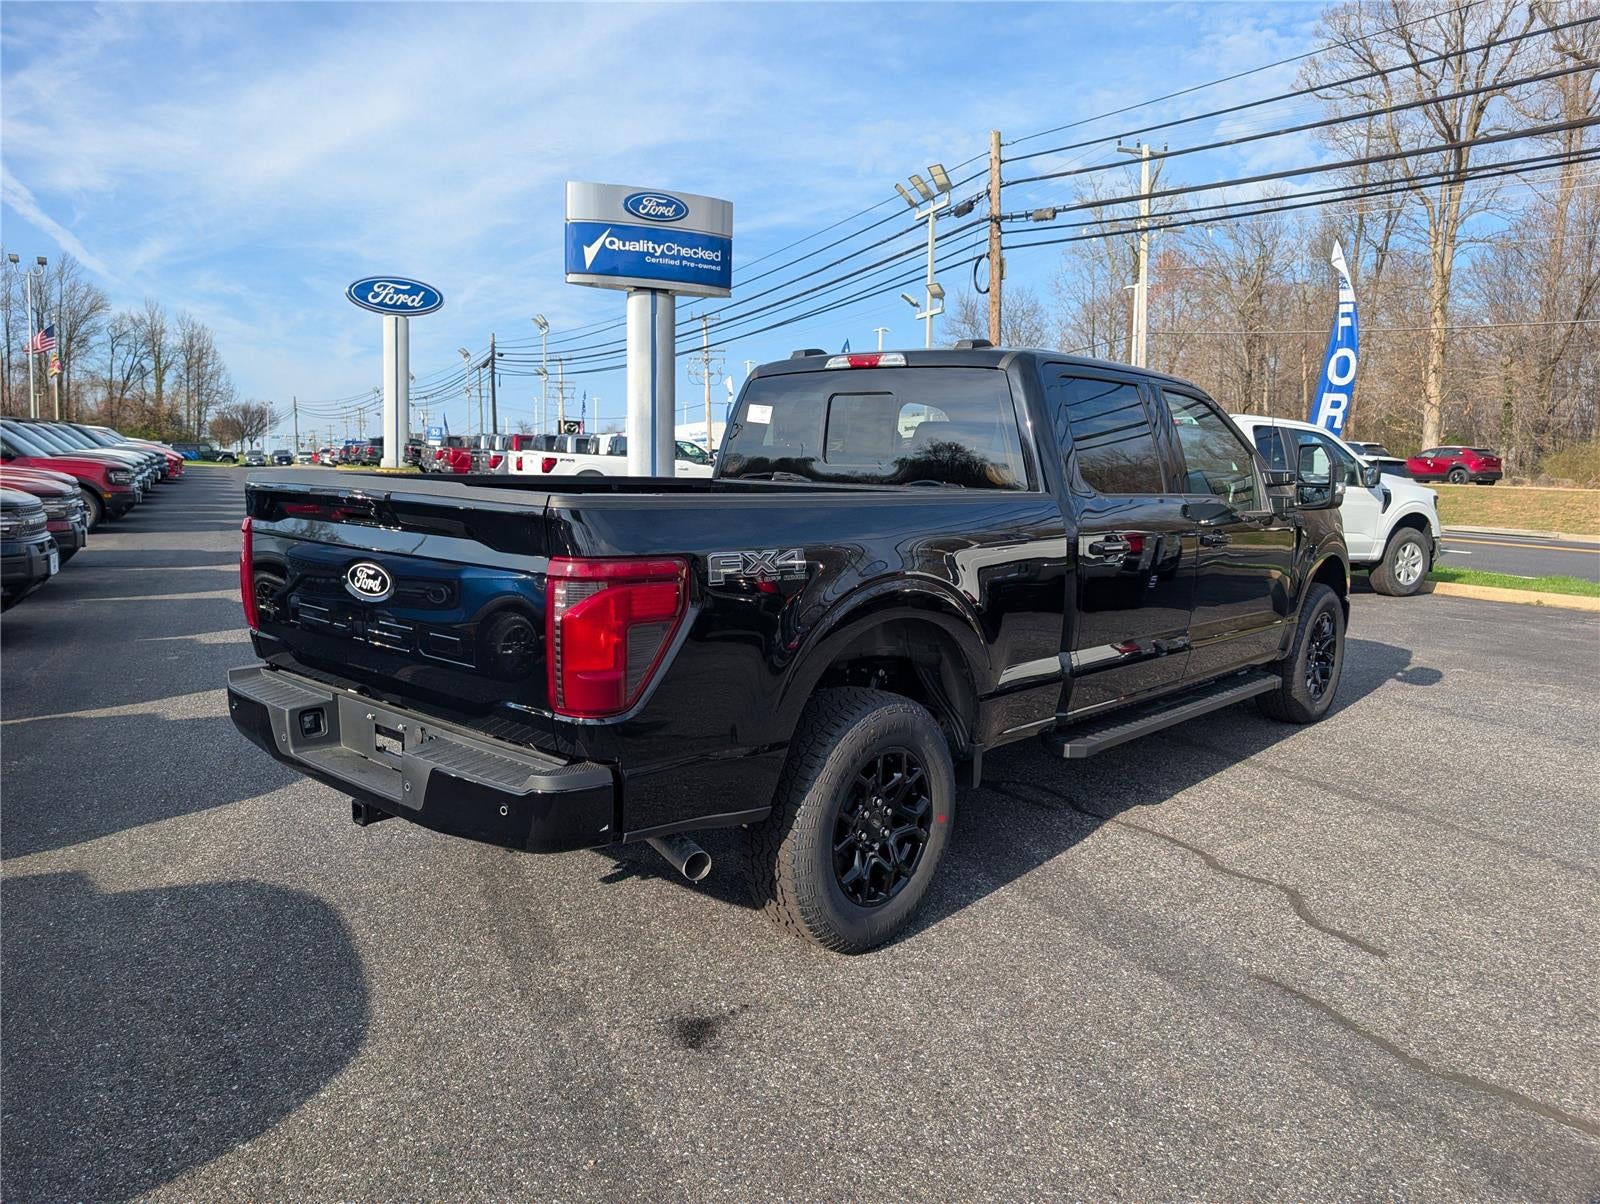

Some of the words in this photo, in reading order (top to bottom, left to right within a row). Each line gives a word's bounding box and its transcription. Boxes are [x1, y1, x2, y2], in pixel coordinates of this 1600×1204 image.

[639, 197, 676, 216] Ford
[645, 256, 680, 266] Certified
[682, 260, 721, 271] Pre-owned
[367, 281, 425, 307] Ford
[354, 566, 382, 592] Ford
[707, 548, 806, 586] FX4
